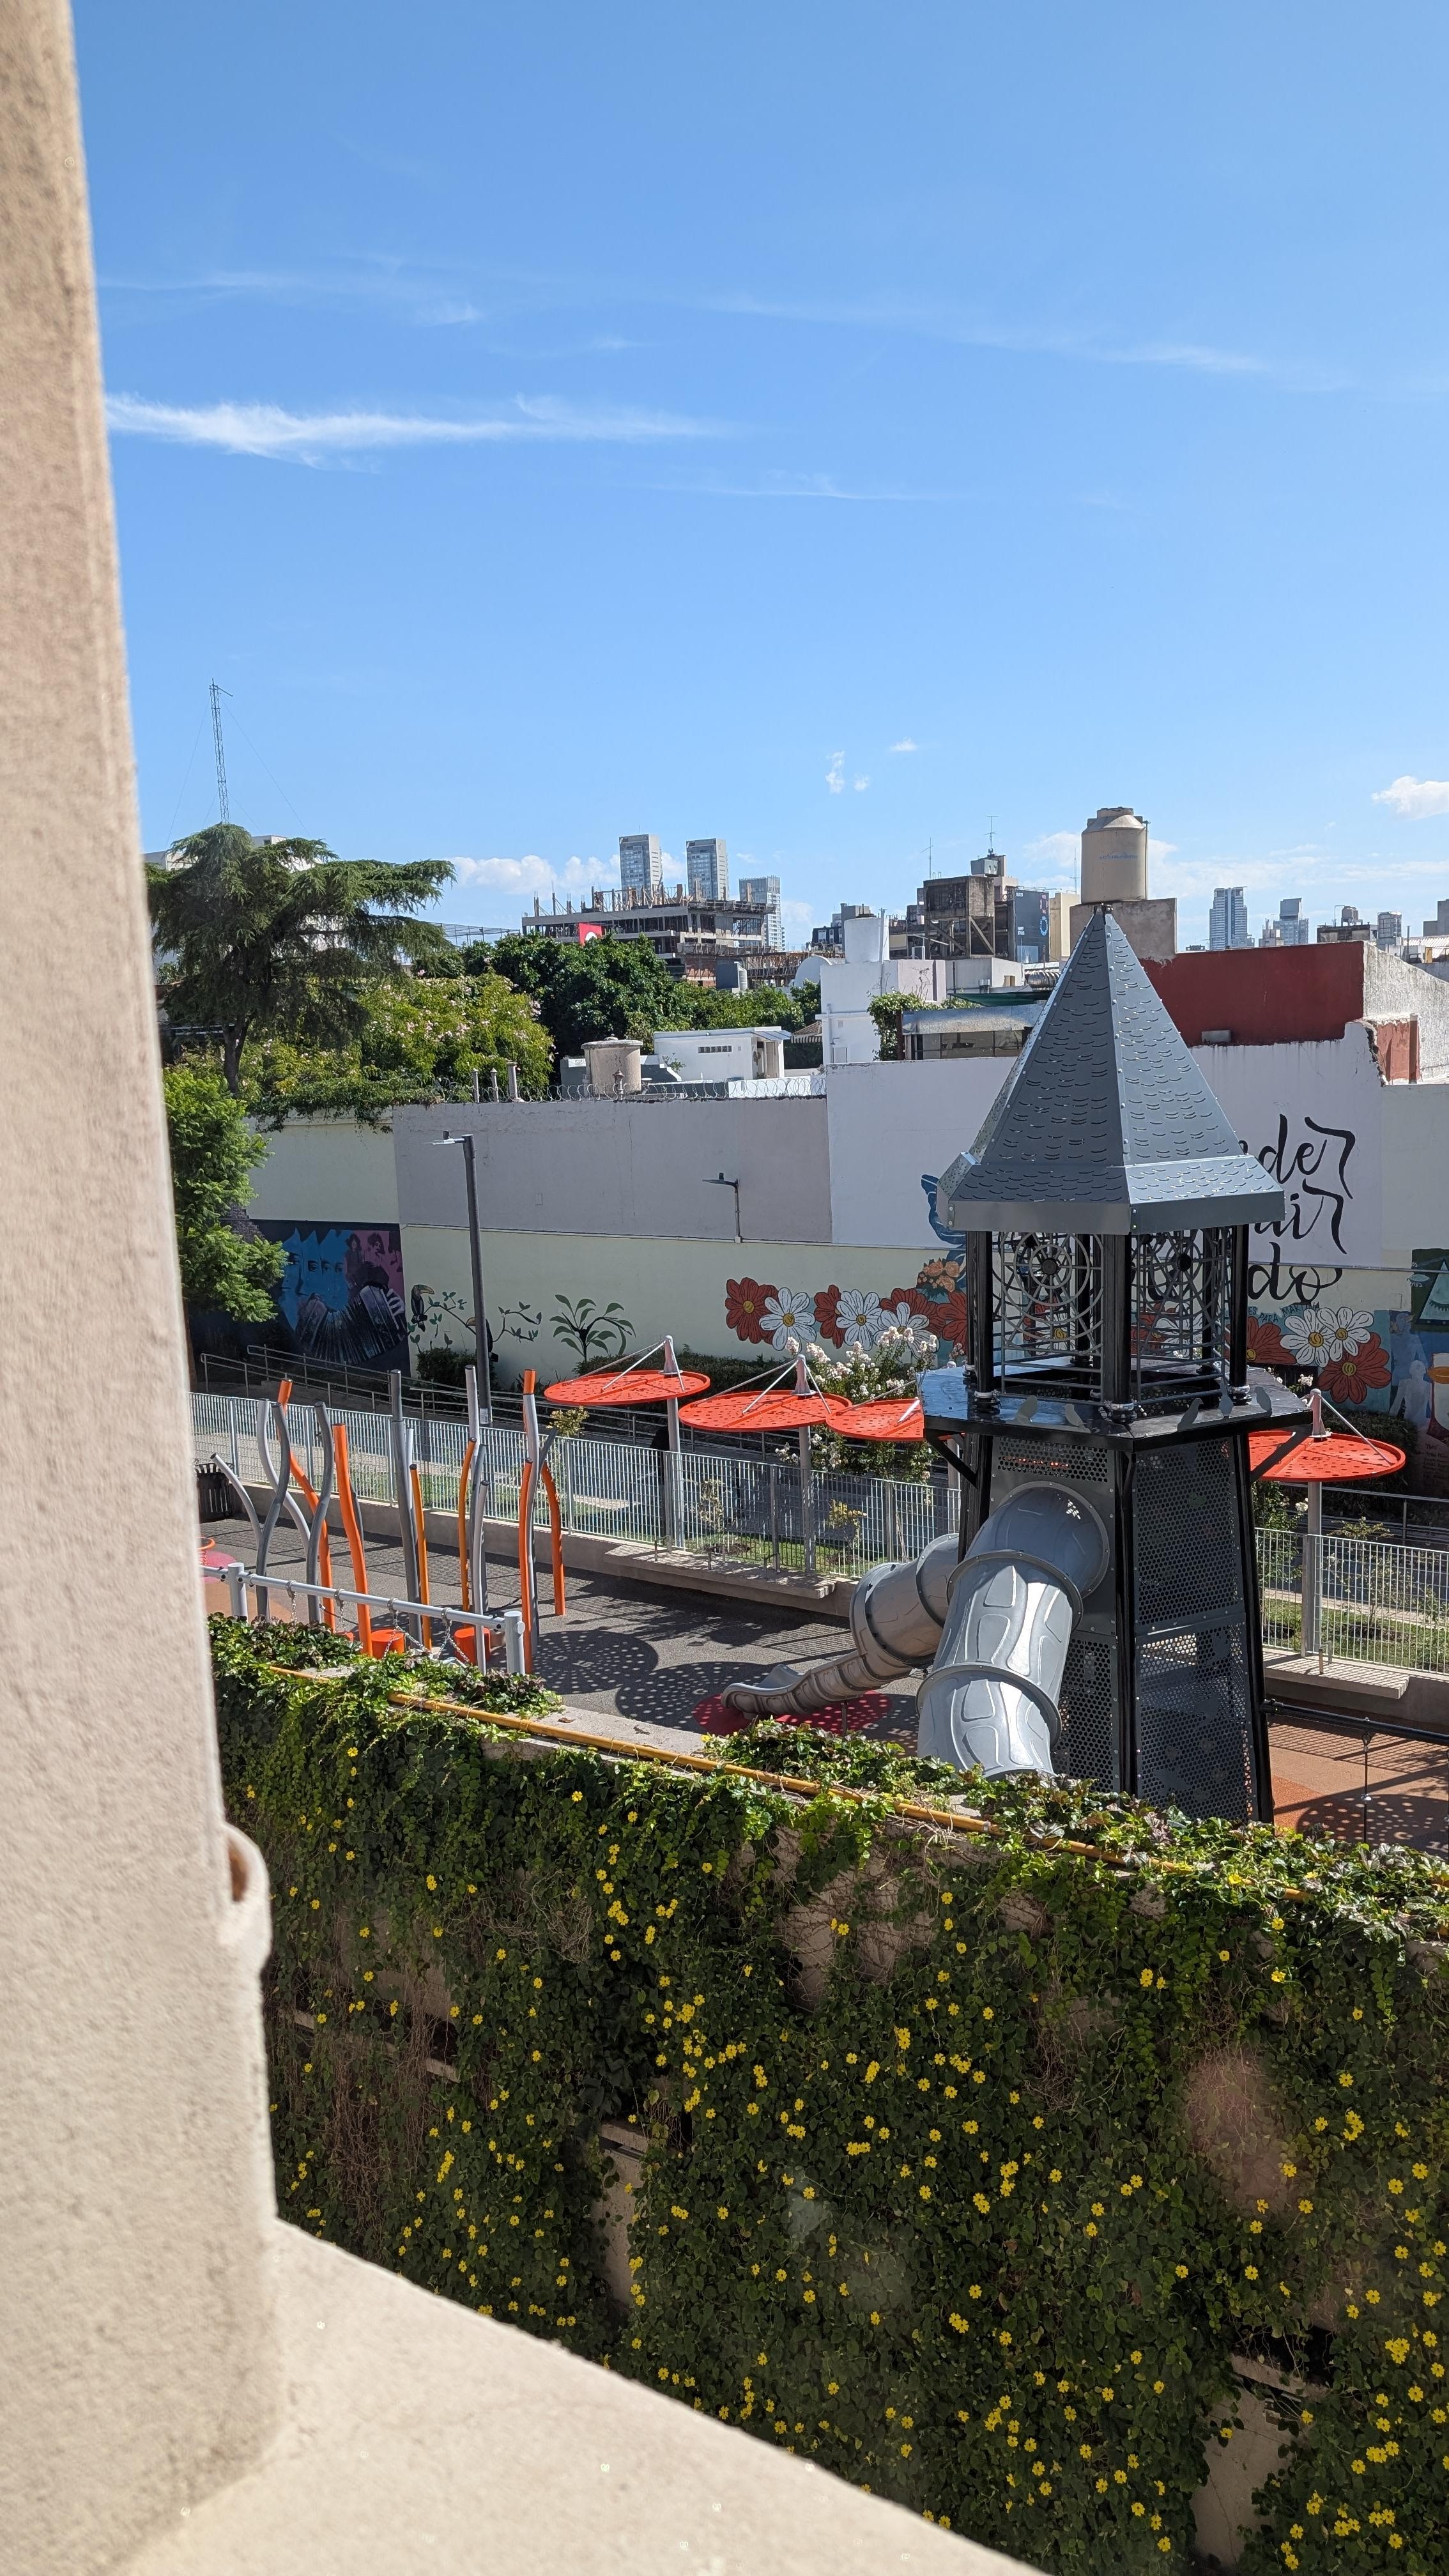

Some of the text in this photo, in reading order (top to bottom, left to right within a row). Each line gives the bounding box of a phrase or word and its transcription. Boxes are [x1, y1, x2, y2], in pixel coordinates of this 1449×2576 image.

[1239, 1114, 1355, 1197] der
[1248, 1242, 1342, 1301] do
[1258, 1312, 1278, 1323] PARA
